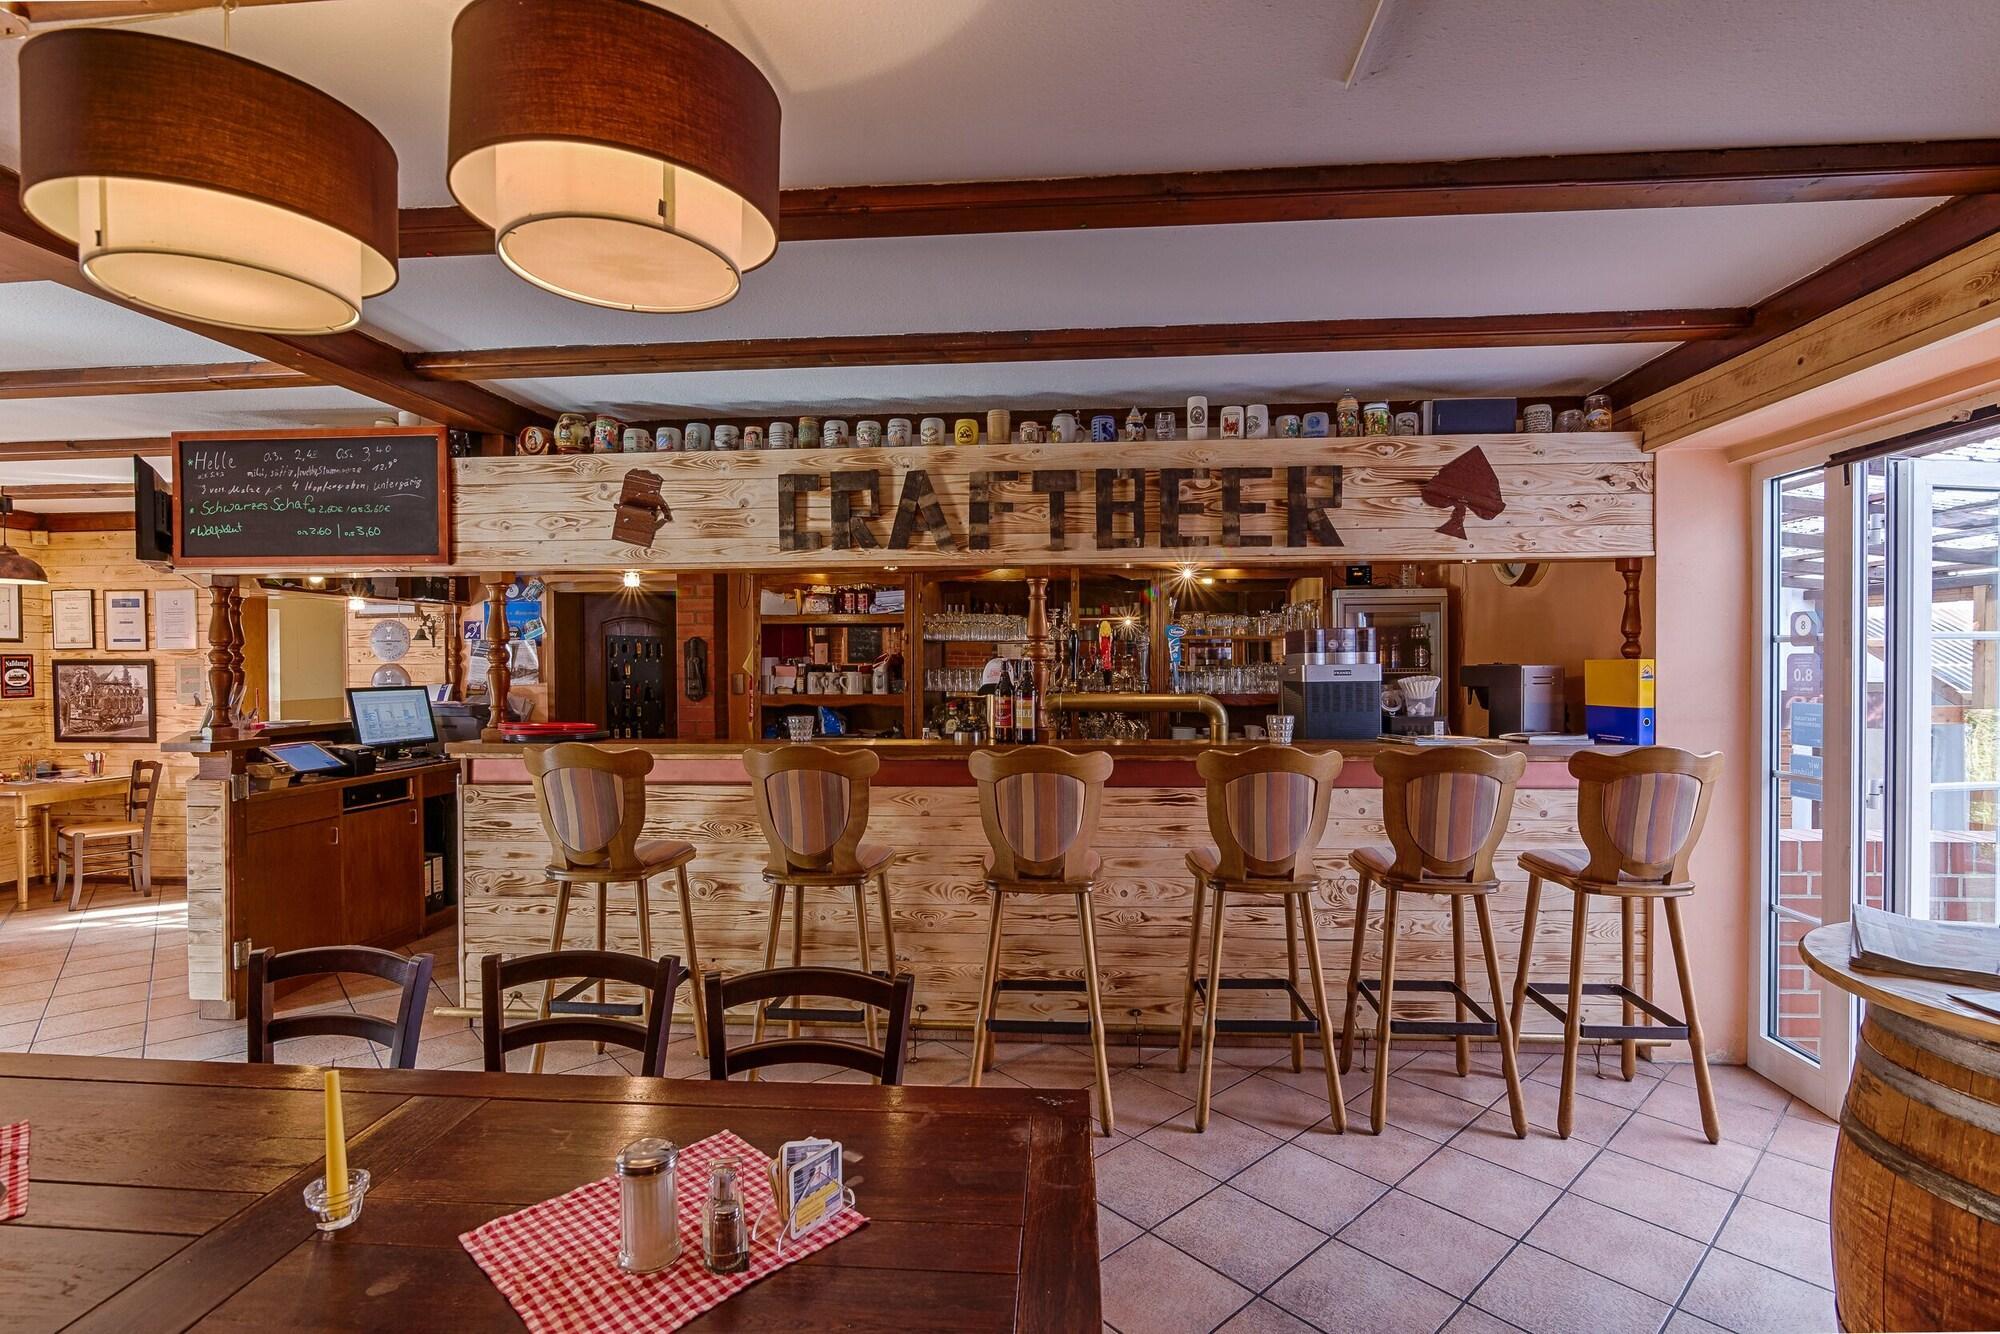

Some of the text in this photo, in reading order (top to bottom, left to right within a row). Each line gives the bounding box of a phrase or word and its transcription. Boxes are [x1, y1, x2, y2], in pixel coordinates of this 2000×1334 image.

[194, 450, 237, 470] Helle
[291, 480, 299, 491] 4
[200, 499, 269, 515] Schwarzes
[270, 494, 314, 512] Schaf
[778, 465, 1344, 552] CRAFTBEER
